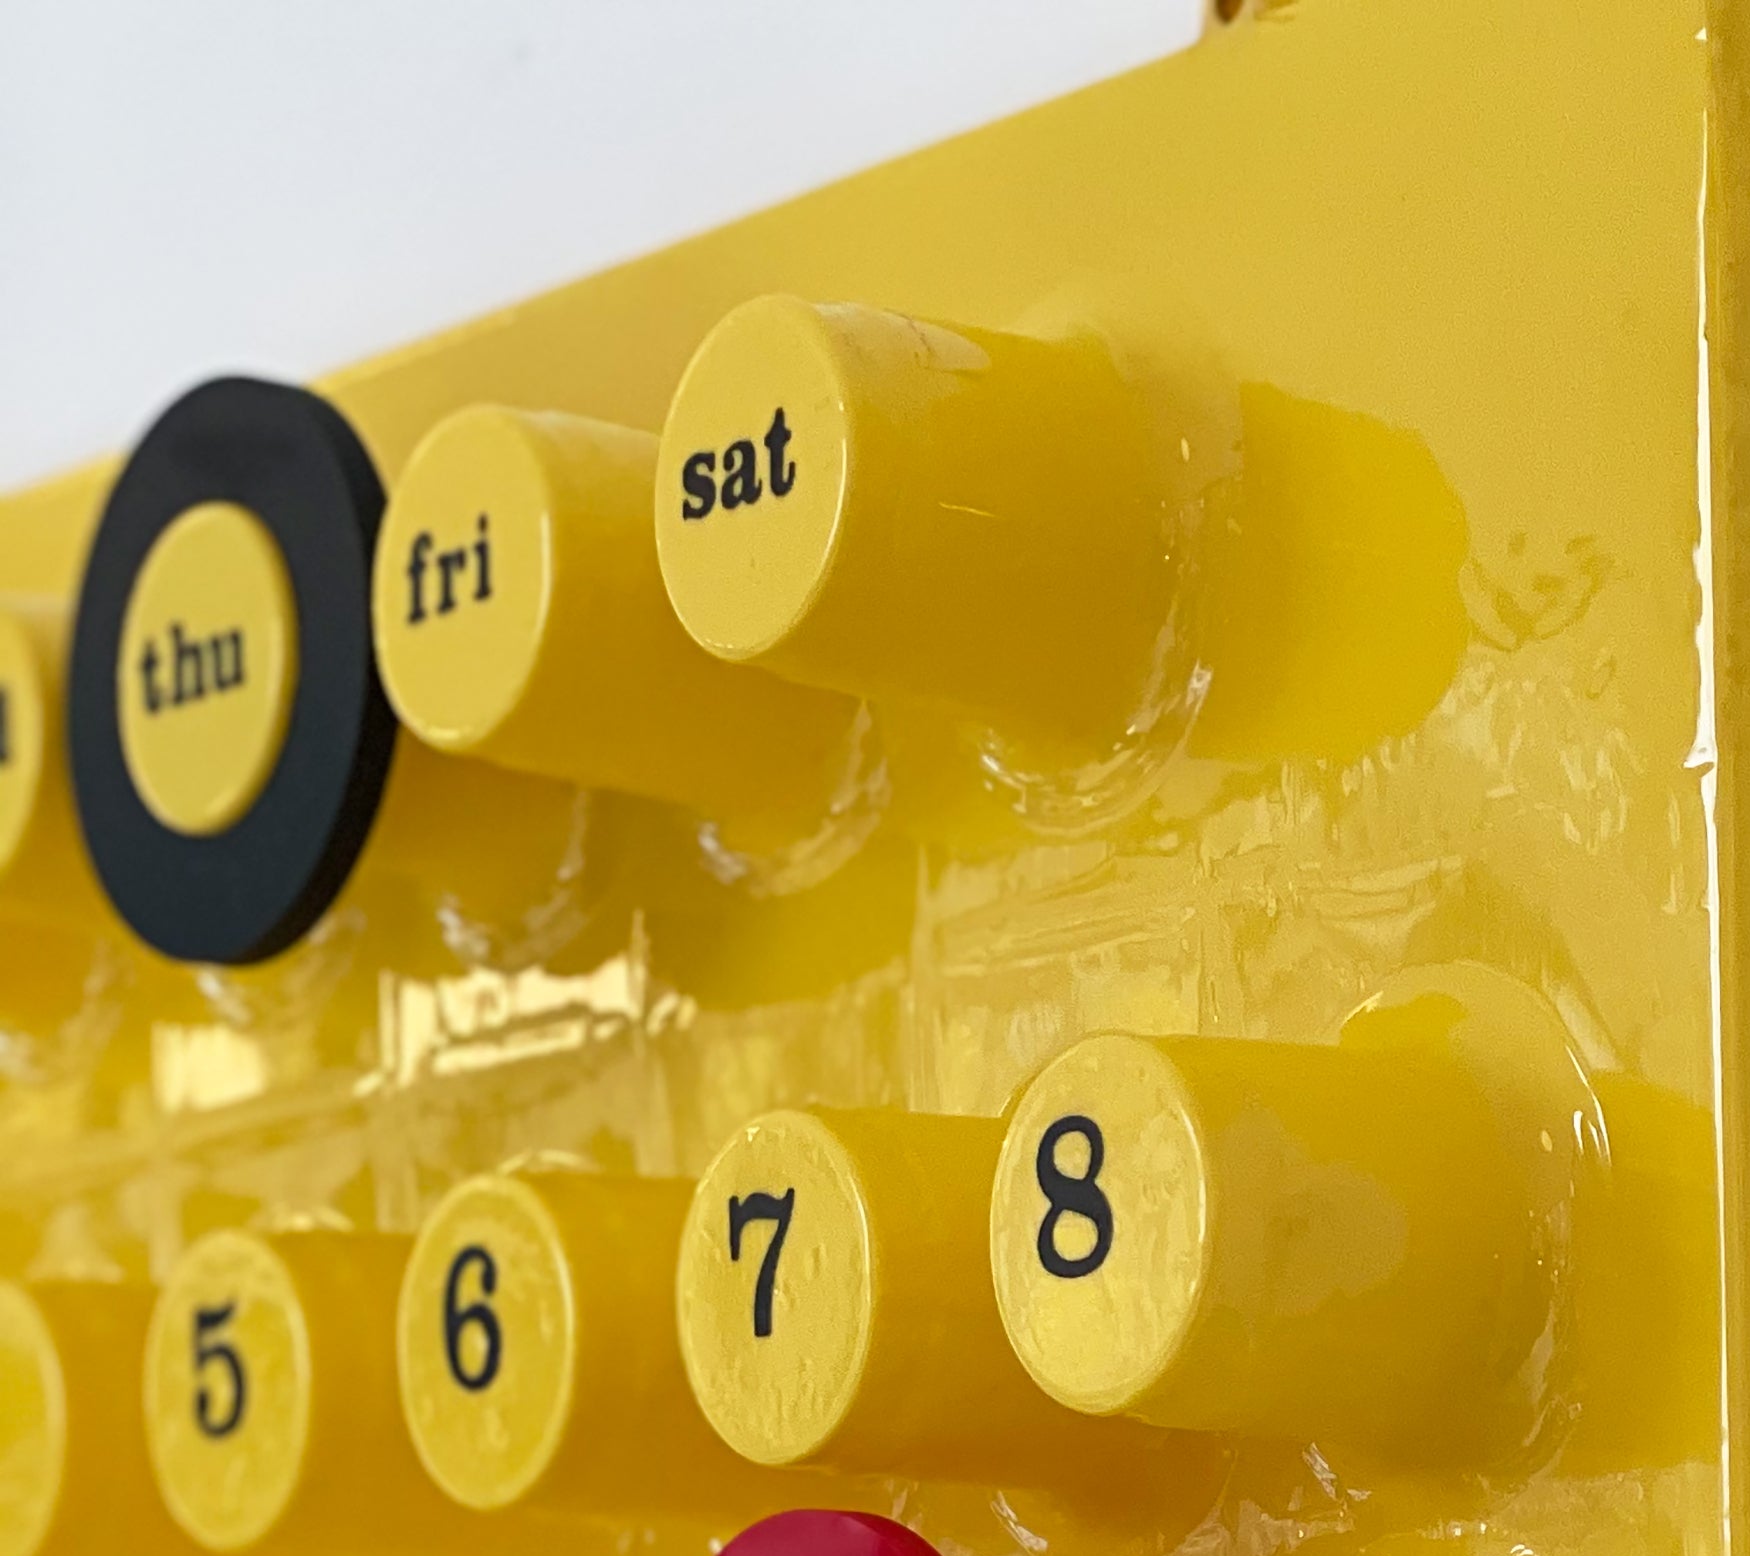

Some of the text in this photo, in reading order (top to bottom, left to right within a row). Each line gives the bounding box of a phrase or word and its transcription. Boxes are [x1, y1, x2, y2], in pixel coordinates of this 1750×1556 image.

[683, 408, 795, 520] sat
[407, 515, 492, 625] fri
[139, 623, 246, 715] thu
[729, 1188, 795, 1337] 7
[1036, 1115, 1113, 1278] 8
[193, 1303, 247, 1439] 5
[443, 1245, 502, 1392] 6
